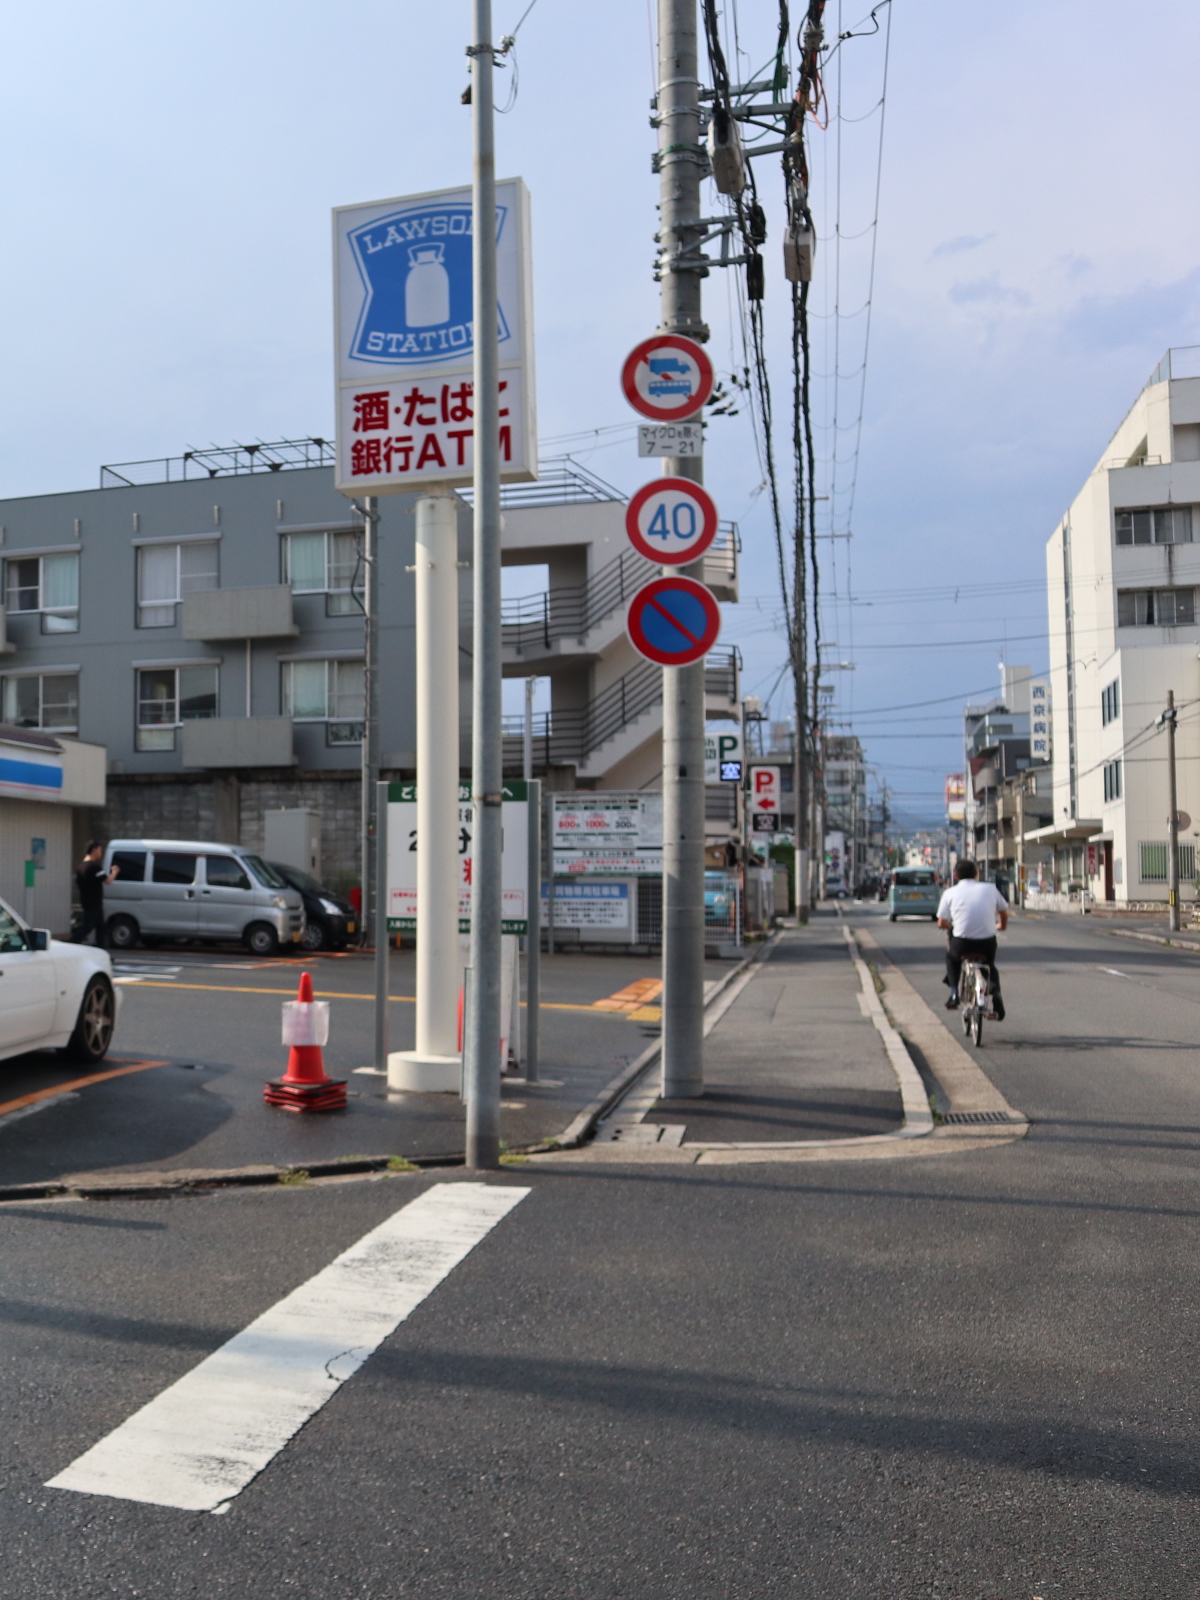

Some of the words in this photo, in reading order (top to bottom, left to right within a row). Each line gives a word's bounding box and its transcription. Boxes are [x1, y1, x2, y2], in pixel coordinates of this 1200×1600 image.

[363, 214, 474, 255] LAWSO
[366, 320, 474, 353] STATIO
[640, 425, 700, 440] マイクロを除く
[647, 501, 697, 541] 40
[1032, 686, 1047, 753] 西京病院
[718, 735, 739, 759] P
[755, 771, 774, 793] P
